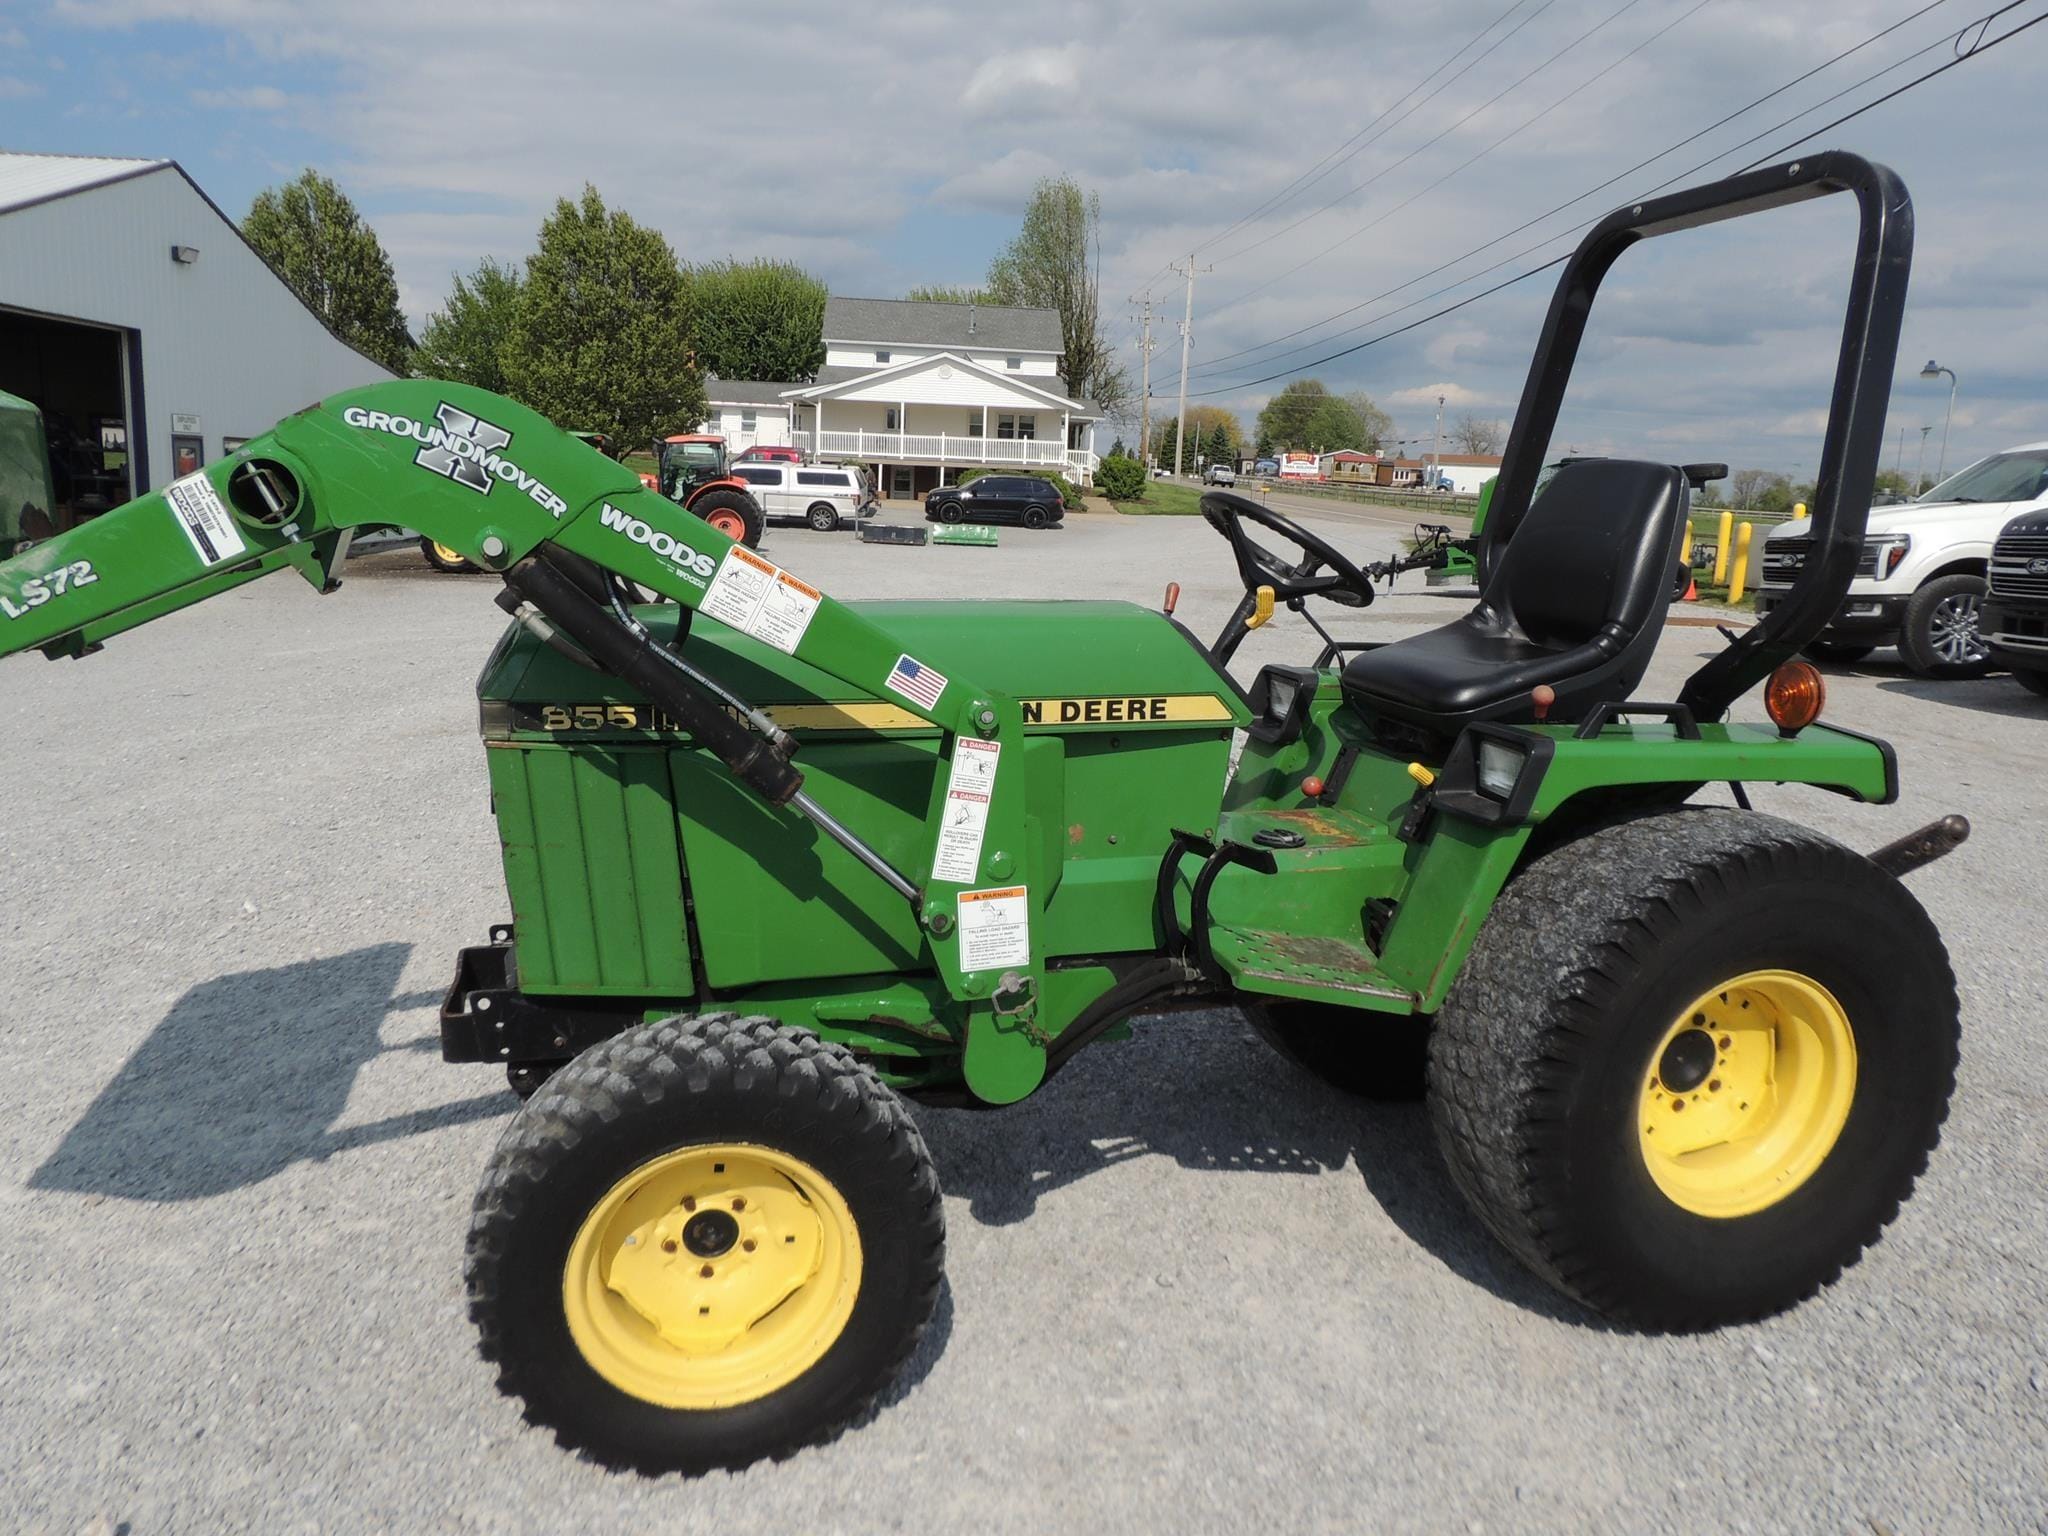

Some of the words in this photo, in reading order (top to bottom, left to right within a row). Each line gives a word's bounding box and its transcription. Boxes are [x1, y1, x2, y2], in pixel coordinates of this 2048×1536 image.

[343, 406, 568, 520] GROUNDMOVER
[171, 487, 199, 526] WOODS
[599, 501, 717, 577] WOODS
[742, 554, 773, 575] WARNING
[0, 559, 99, 619] LS72
[674, 568, 706, 589] WOODS
[787, 578, 818, 598] WARNING
[542, 706, 637, 731] 855
[1061, 699, 1167, 722] DEERE
[969, 741, 996, 751] DANGER
[959, 793, 986, 803] DANGER
[982, 890, 1013, 899] WARNING
